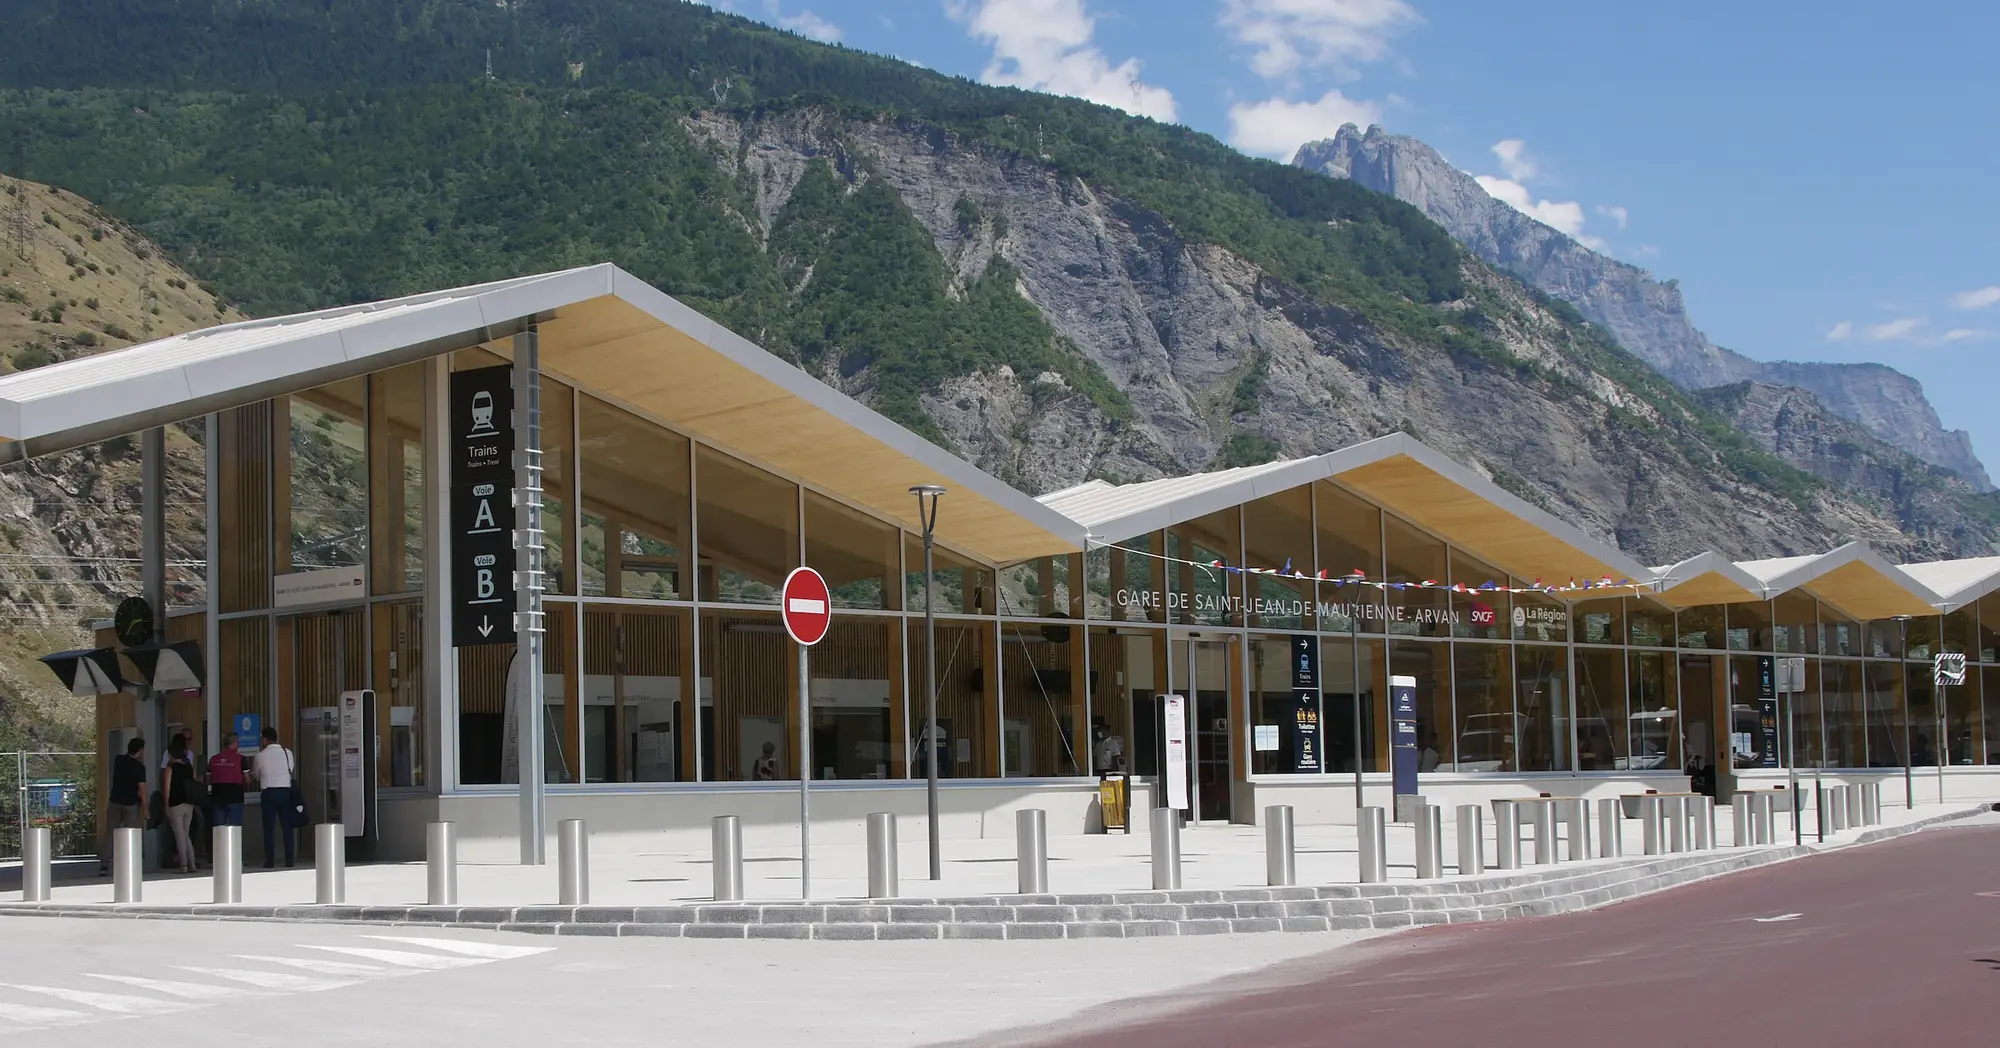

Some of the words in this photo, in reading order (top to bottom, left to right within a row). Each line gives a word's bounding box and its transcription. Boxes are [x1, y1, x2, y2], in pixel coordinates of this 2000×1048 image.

[468, 444, 498, 458] Trains
[475, 485, 492, 495] Voie
[474, 498, 495, 528] A
[476, 556, 493, 565] Voie
[477, 568, 495, 598] B
[1116, 589, 1161, 608] GARE
[1168, 592, 1189, 609] DE
[1414, 608, 1460, 624] ARVAN
[1471, 610, 1494, 622] SNCF
[1526, 607, 1536, 619] La
[1537, 607, 1567, 623] Région
